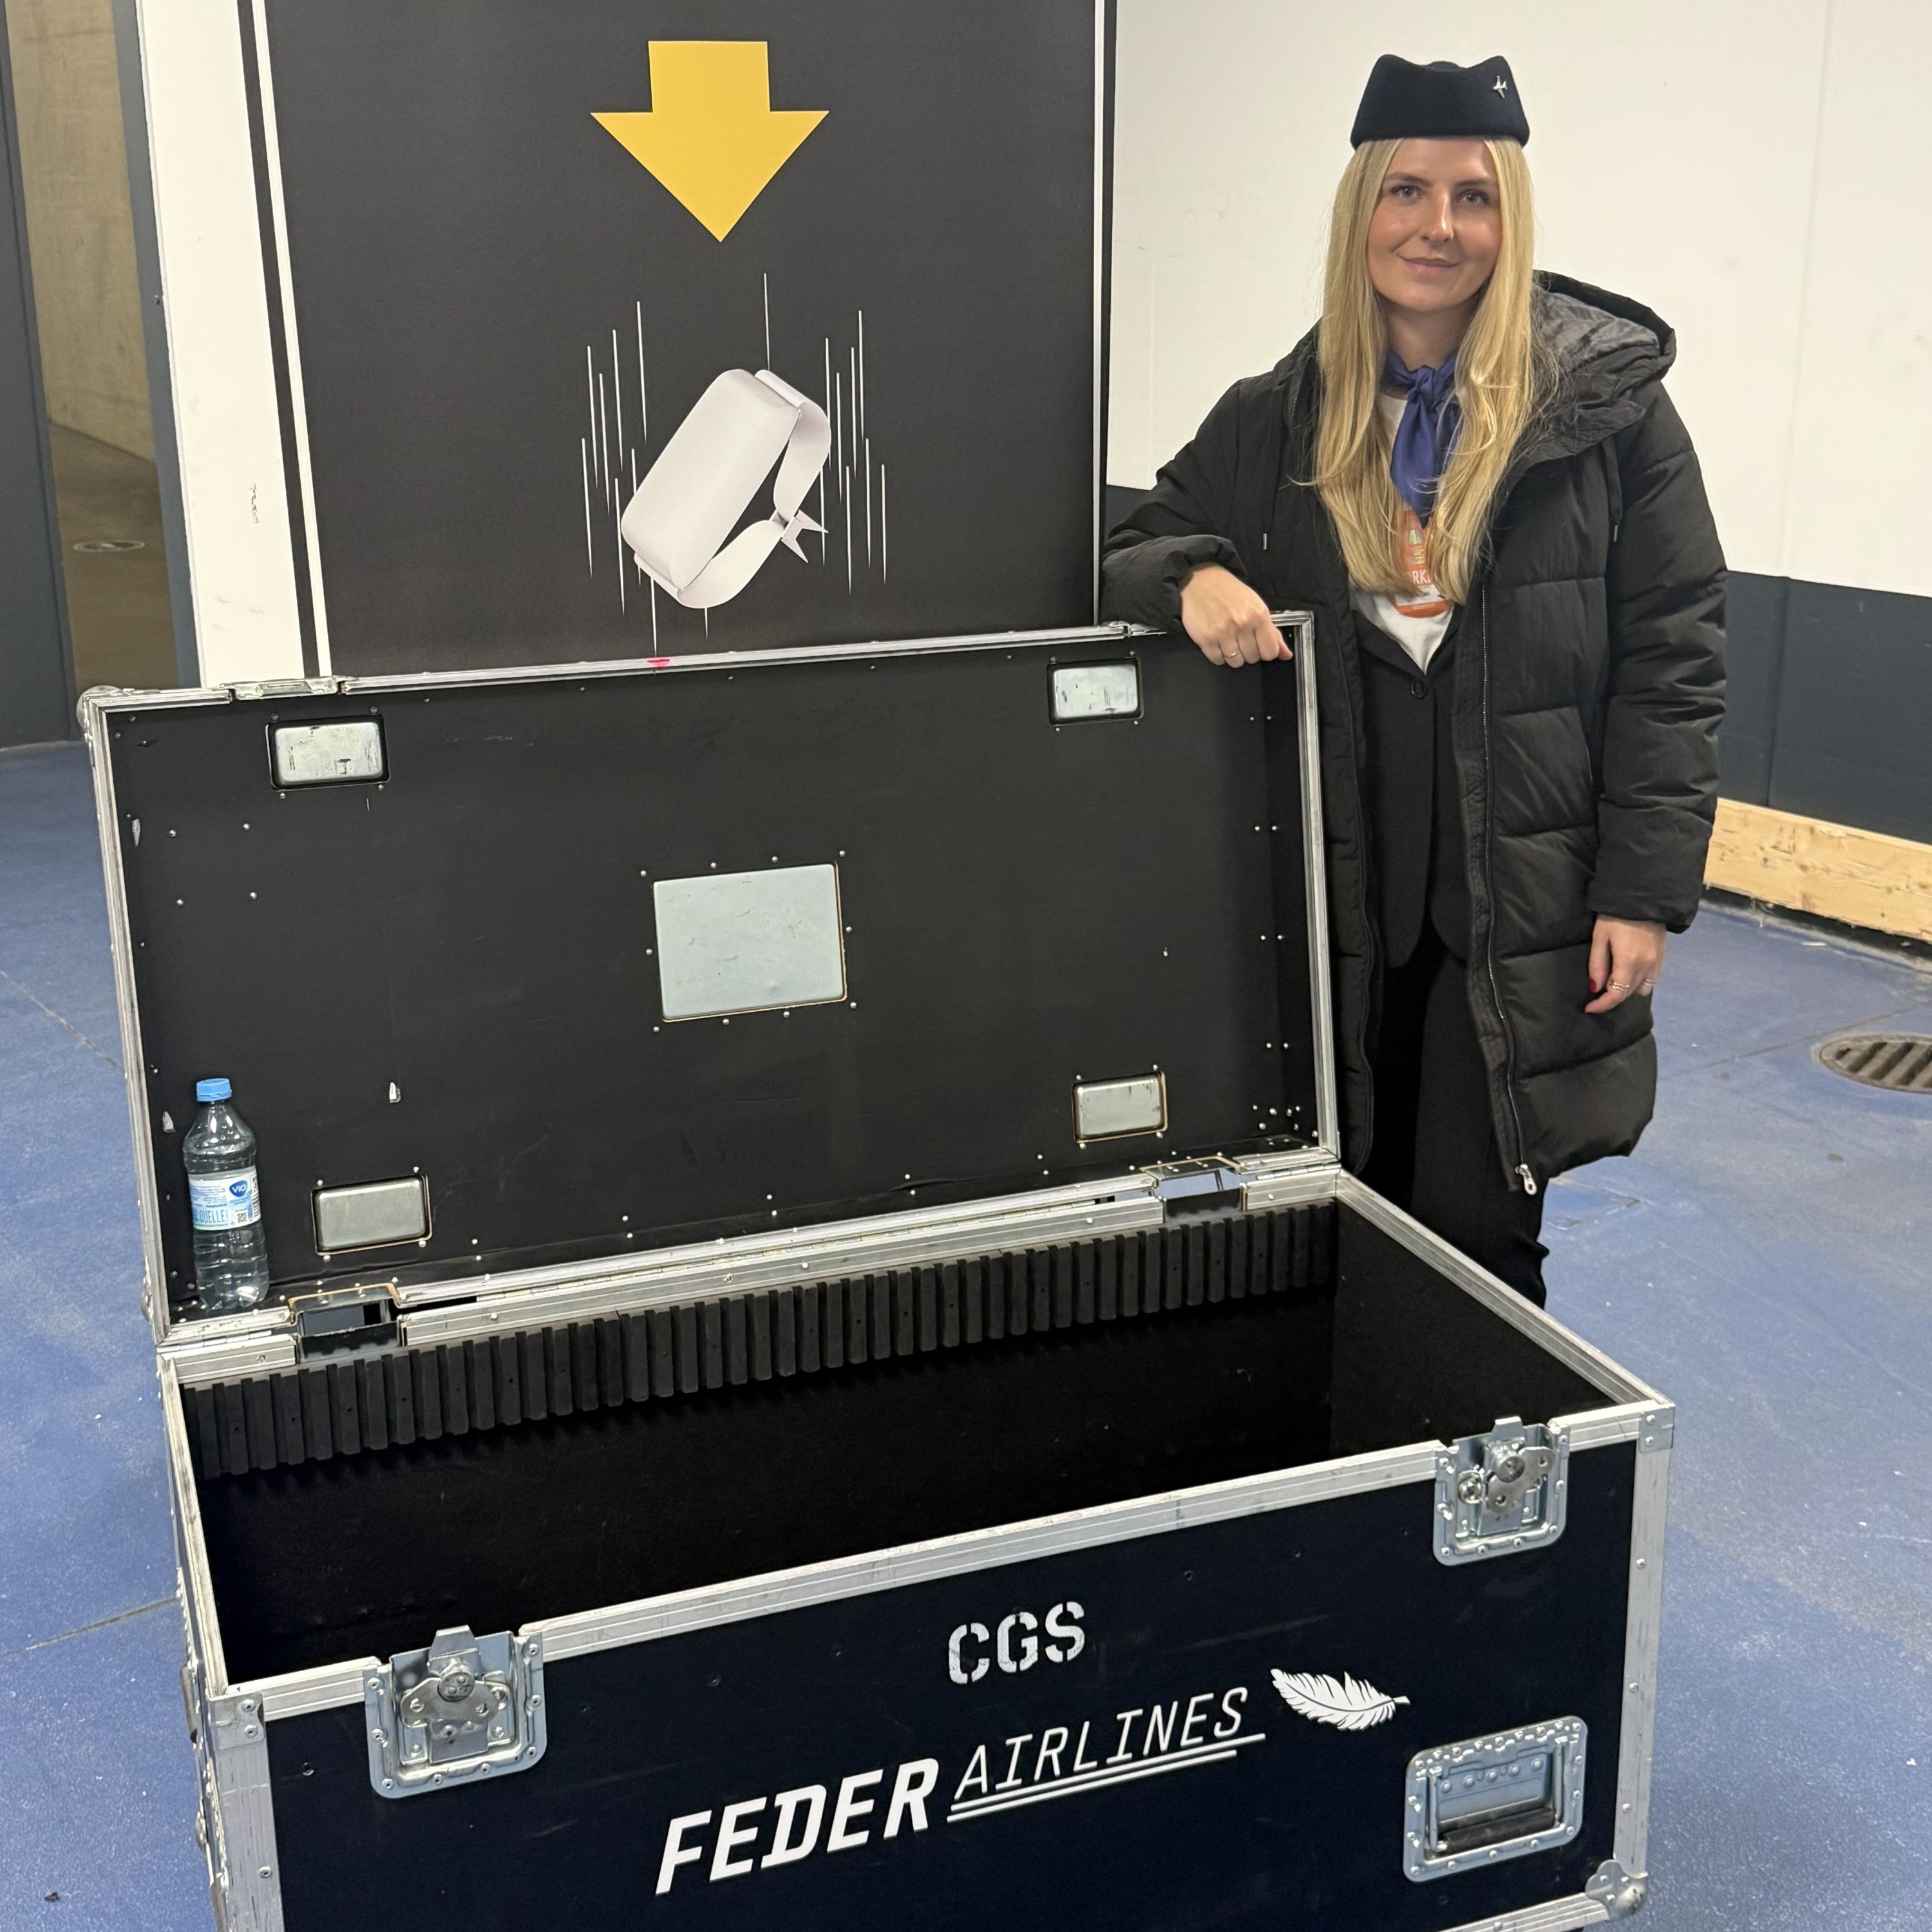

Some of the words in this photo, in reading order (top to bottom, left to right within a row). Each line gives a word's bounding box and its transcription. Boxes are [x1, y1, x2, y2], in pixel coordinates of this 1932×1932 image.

[949, 1601, 1085, 1684] CGS
[655, 1757, 939, 1895] FEDER
[954, 1687, 1248, 1800] AIRLINES
